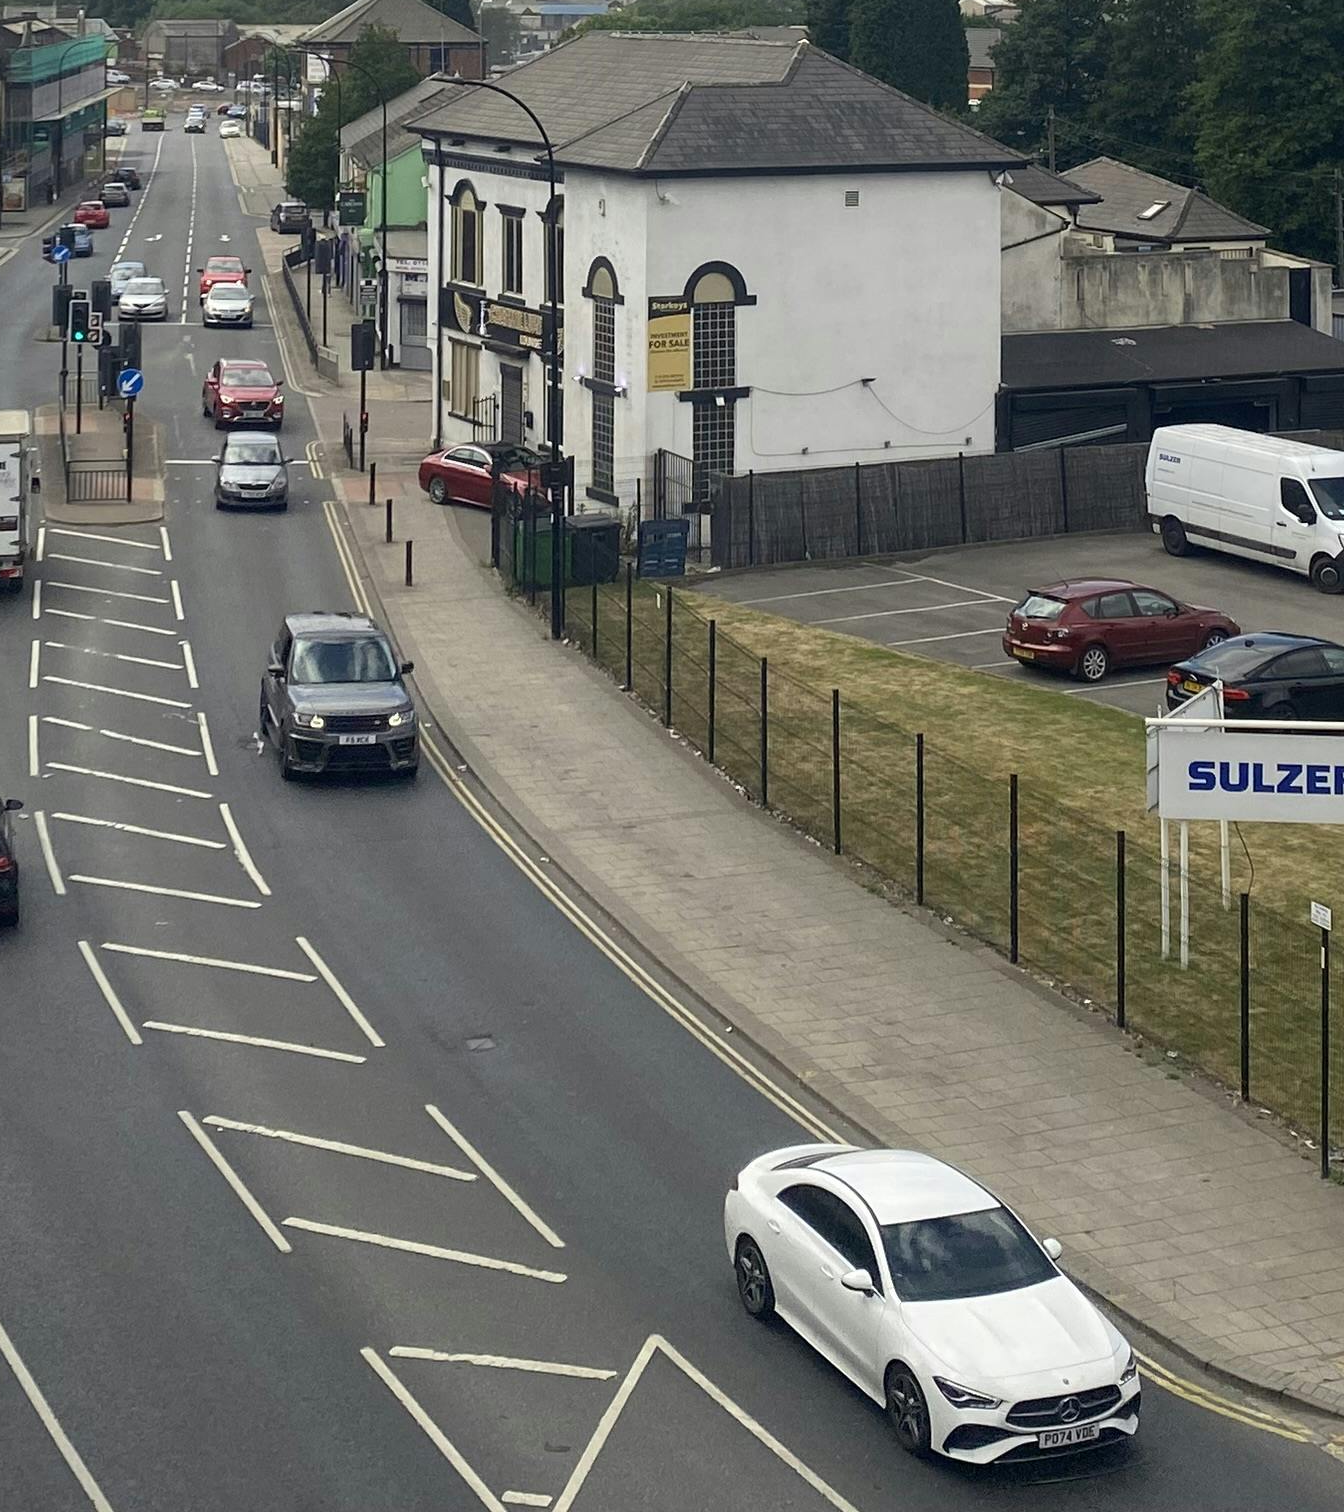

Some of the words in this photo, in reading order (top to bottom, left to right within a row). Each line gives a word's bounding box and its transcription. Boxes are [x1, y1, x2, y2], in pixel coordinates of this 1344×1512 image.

[650, 331, 689, 339] INVESTMENT
[649, 339, 667, 349] FOR
[669, 338, 689, 347] SALE
[1076, 1425, 1096, 1440] VDE
